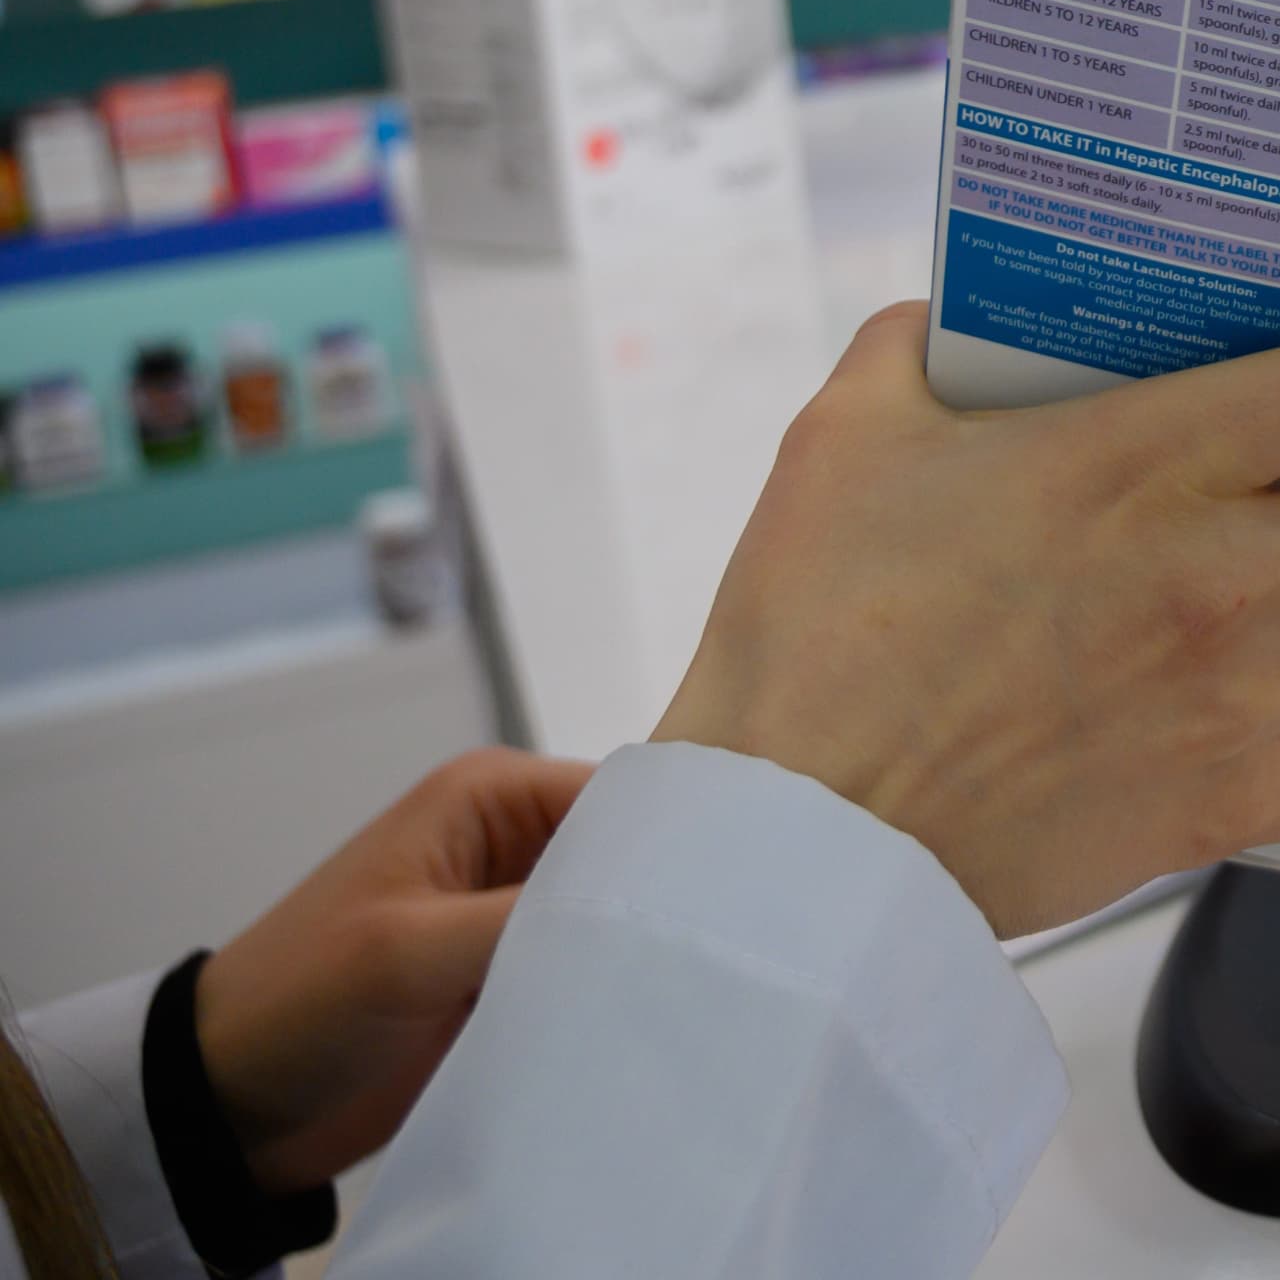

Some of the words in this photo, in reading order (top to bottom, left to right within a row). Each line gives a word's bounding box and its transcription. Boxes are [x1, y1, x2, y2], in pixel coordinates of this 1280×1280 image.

[1045, 4, 1053, 17] 5
[1055, 6, 1074, 22] TO
[1078, 12, 1093, 26] 12
[1096, 16, 1139, 37] YEARS
[1198, 15, 1268, 42] spoonfuls),
[1217, 3, 1234, 15] ml
[1237, 7, 1271, 24] twice
[969, 28, 1037, 55] CHILDREN
[1042, 45, 1047, 58] 1
[1051, 47, 1070, 63] TO
[1073, 53, 1081, 66] 5
[1084, 55, 1127, 77] YEARS
[1193, 40, 1209, 54] 10
[1212, 46, 1228, 59] ml
[1231, 50, 1265, 67] twice
[1193, 59, 1262, 85] spoonfuls),
[965, 69, 1033, 97] CHILDREN
[1037, 86, 1084, 109] UNDER
[1089, 99, 1094, 111] 1
[1098, 101, 1133, 121] YEAR
[1188, 98, 1251, 122] spoonful).
[1189, 81, 1198, 93] 5
[1201, 85, 1218, 98] ml
[1220, 89, 1254, 106] twice
[961, 109, 1003, 131] HOW
[1006, 120, 1029, 137] TO
[1031, 126, 1073, 148] TAKE
[1077, 137, 1092, 152] IT
[1095, 142, 1111, 157] in
[1115, 146, 1178, 173] Hepatic
[1183, 138, 1245, 162] spoonful).
[961, 153, 974, 165] to
[977, 158, 1027, 178] produce
[1031, 169, 1037, 181] 2
[1041, 172, 1054, 185] to
[1057, 176, 1064, 188] 3
[1067, 181, 1089, 194] soft
[1092, 187, 1129, 203] stools
[1131, 193, 1163, 214] daily.
[962, 135, 977, 149] 30
[979, 140, 992, 153] to
[995, 144, 1010, 157] 50
[1013, 150, 1029, 162] ml
[1032, 153, 1064, 171] three
[1067, 162, 1100, 180] times
[1103, 170, 1132, 191] daily
[1135, 178, 1148, 192] (6
[1159, 184, 1173, 198] 10
[1175, 191, 1183, 200] x
[1186, 191, 1193, 202] 5
[1197, 195, 1213, 207] ml
[957, 176, 978, 191] DO
[982, 182, 1008, 199] NOT
[1012, 189, 1044, 208] TAKE
[1048, 199, 1086, 219] MORE
[1089, 210, 1155, 236] MEDICINE
[1157, 226, 1196, 245] THAN
[1199, 236, 1225, 252] THE
[1228, 243, 1270, 262] LABEL
[989, 198, 1001, 212] IF
[1003, 202, 1031, 219] YOU
[1034, 210, 1055, 225] DO
[1058, 216, 1085, 233] NOT
[1089, 224, 1114, 241] GET
[1117, 231, 1167, 253] BETTER
[1174, 245, 1207, 262] TALK
[1209, 253, 1228, 267] TO
[1230, 257, 1268, 275] YOUR
[1056, 242, 1074, 256] Do
[1078, 249, 1099, 262] not
[1102, 254, 1130, 269] take
[1133, 261, 1195, 284] Lactulose
[1198, 276, 1257, 298] Solution:
[1072, 304, 1133, 329] Warnings
[1136, 319, 1145, 331] &
[1148, 322, 1229, 350] Precautions:
